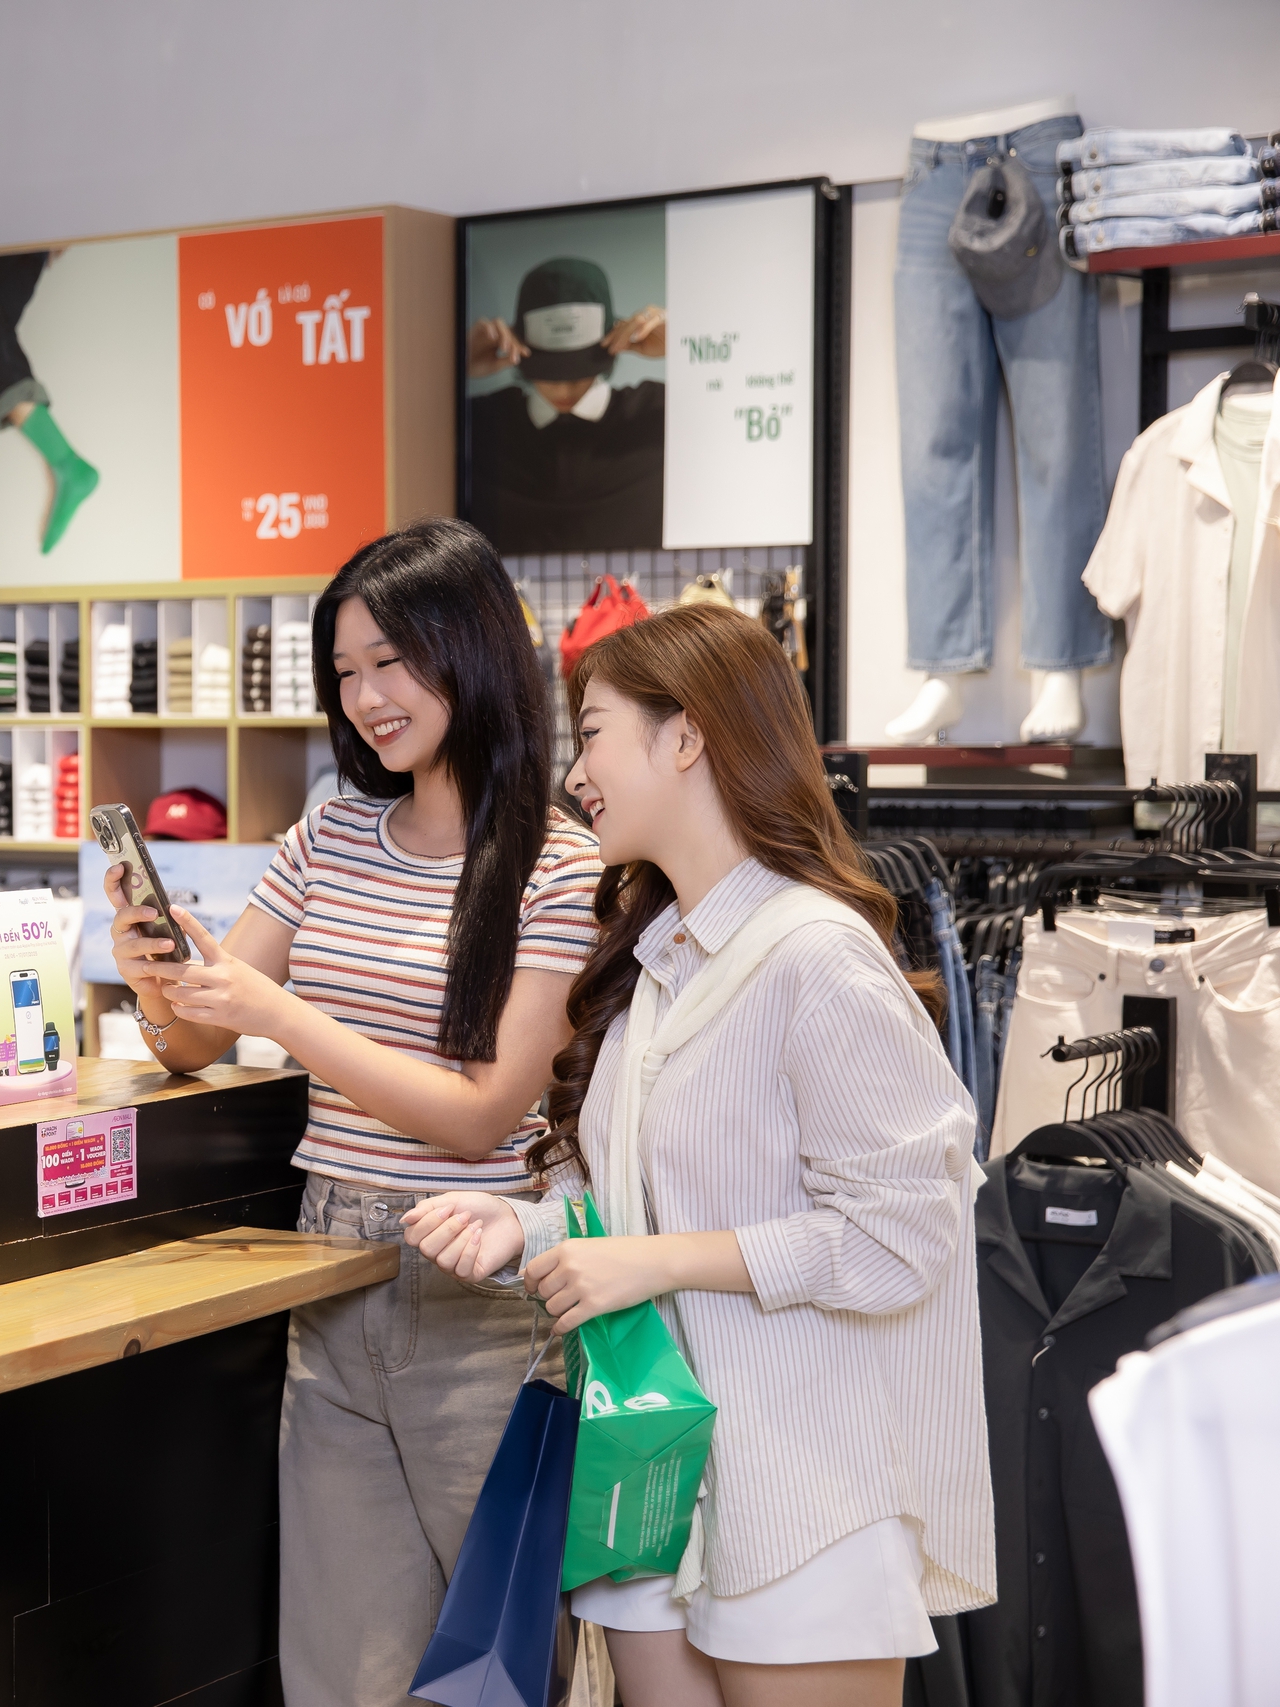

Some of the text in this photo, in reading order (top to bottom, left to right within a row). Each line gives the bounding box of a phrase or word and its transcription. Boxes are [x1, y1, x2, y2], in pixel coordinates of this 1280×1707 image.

[295, 288, 371, 366] TẤT
[256, 492, 302, 539] 25
[3, 928, 21, 943] ĐẾN
[21, 921, 53, 941] 50%
[41, 1153, 60, 1169] 100
[60, 1157, 75, 1165] WAON
[80, 1148, 85, 1161] 1
[86, 1151, 106, 1159] VOUCHER
